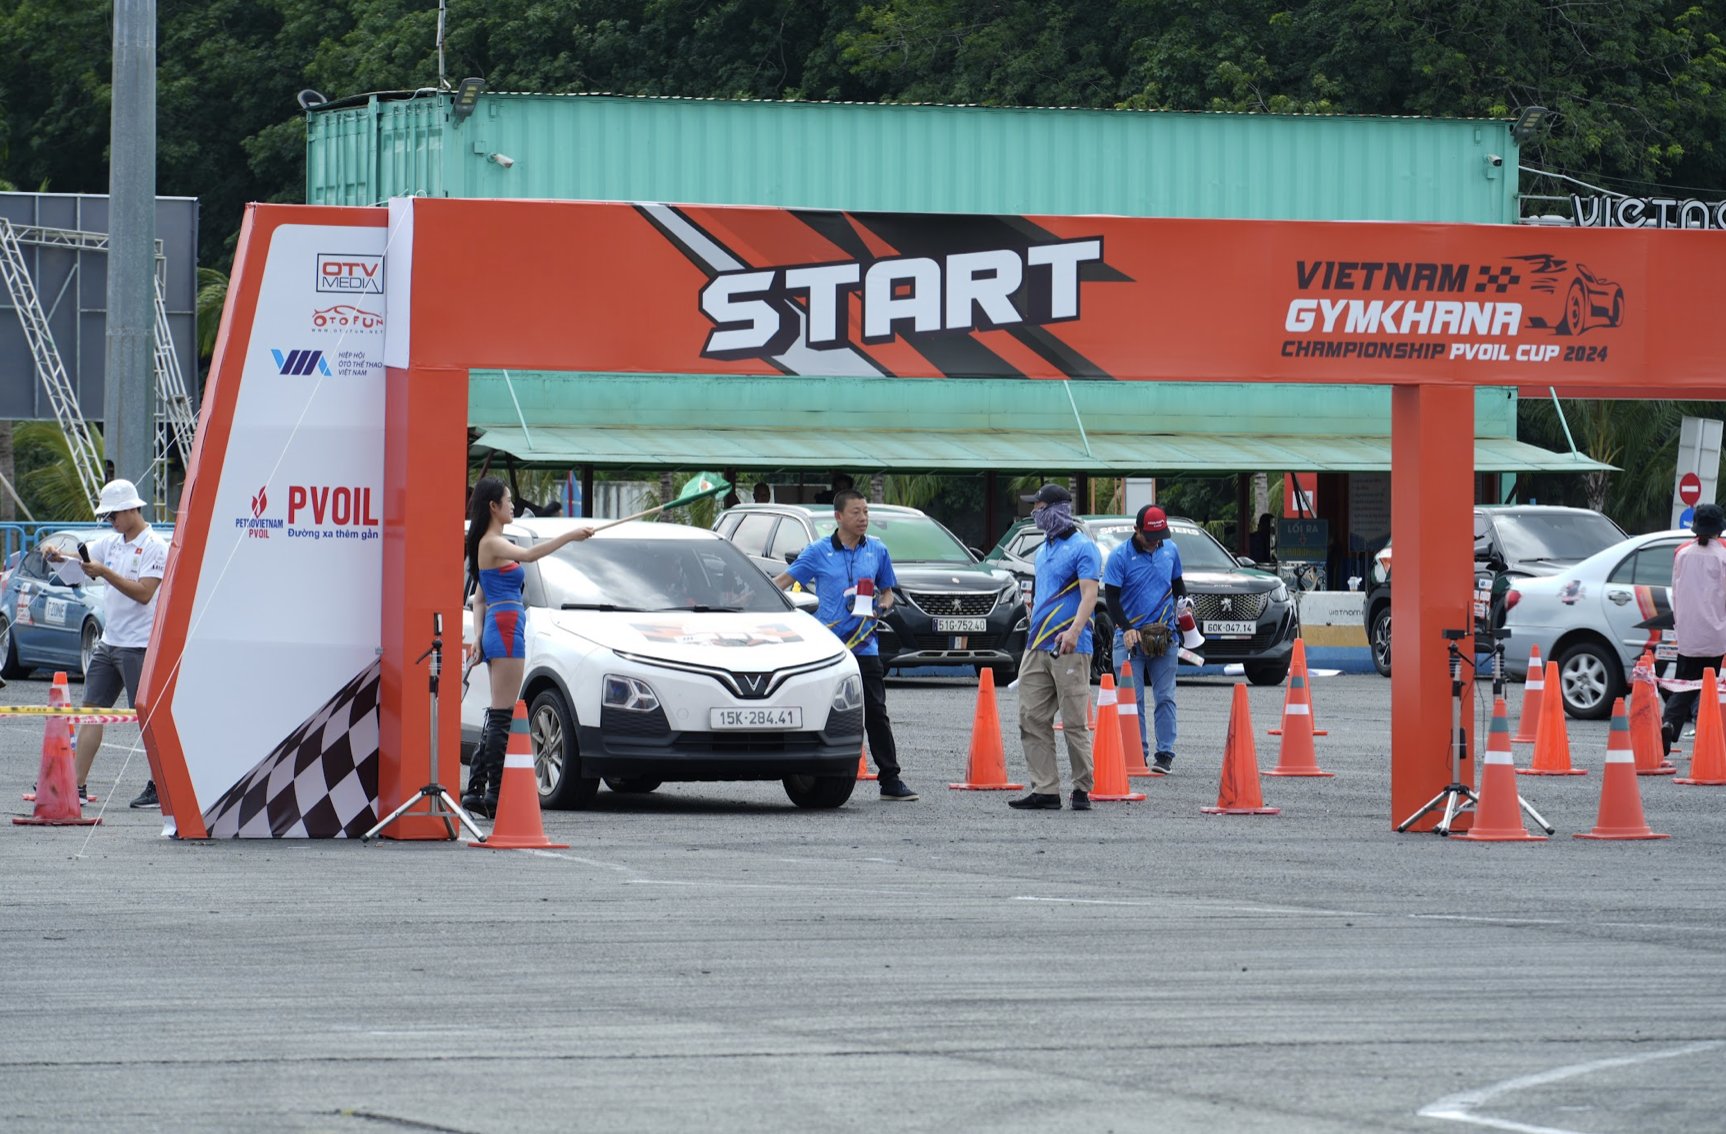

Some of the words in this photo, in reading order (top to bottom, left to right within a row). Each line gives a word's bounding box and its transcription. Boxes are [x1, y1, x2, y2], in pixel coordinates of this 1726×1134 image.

[322, 262, 379, 277] OTV
[1296, 261, 1470, 293] VIETNAM
[322, 276, 380, 292] MEDIA
[701, 239, 1101, 354] START
[313, 314, 384, 329] OTOFUN
[1285, 299, 1523, 336] GYMKHANA
[1281, 340, 1446, 360] CHAMPIONSHIP
[1449, 343, 1511, 361] PVOIL
[1515, 344, 1560, 362] CUP
[1563, 345, 1609, 362] 2024
[366, 361, 384, 369] THAO
[353, 369, 367, 377] NAM
[287, 485, 379, 526] PVOIL
[248, 528, 270, 539] PVOIL
[287, 527, 320, 540] Đường
[322, 531, 334, 539] xa
[335, 529, 359, 539] thêm
[938, 619, 986, 631] 51G-752.40
[1207, 623, 1252, 632] 60K-047.14
[720, 711, 793, 725] 15K-284.41
